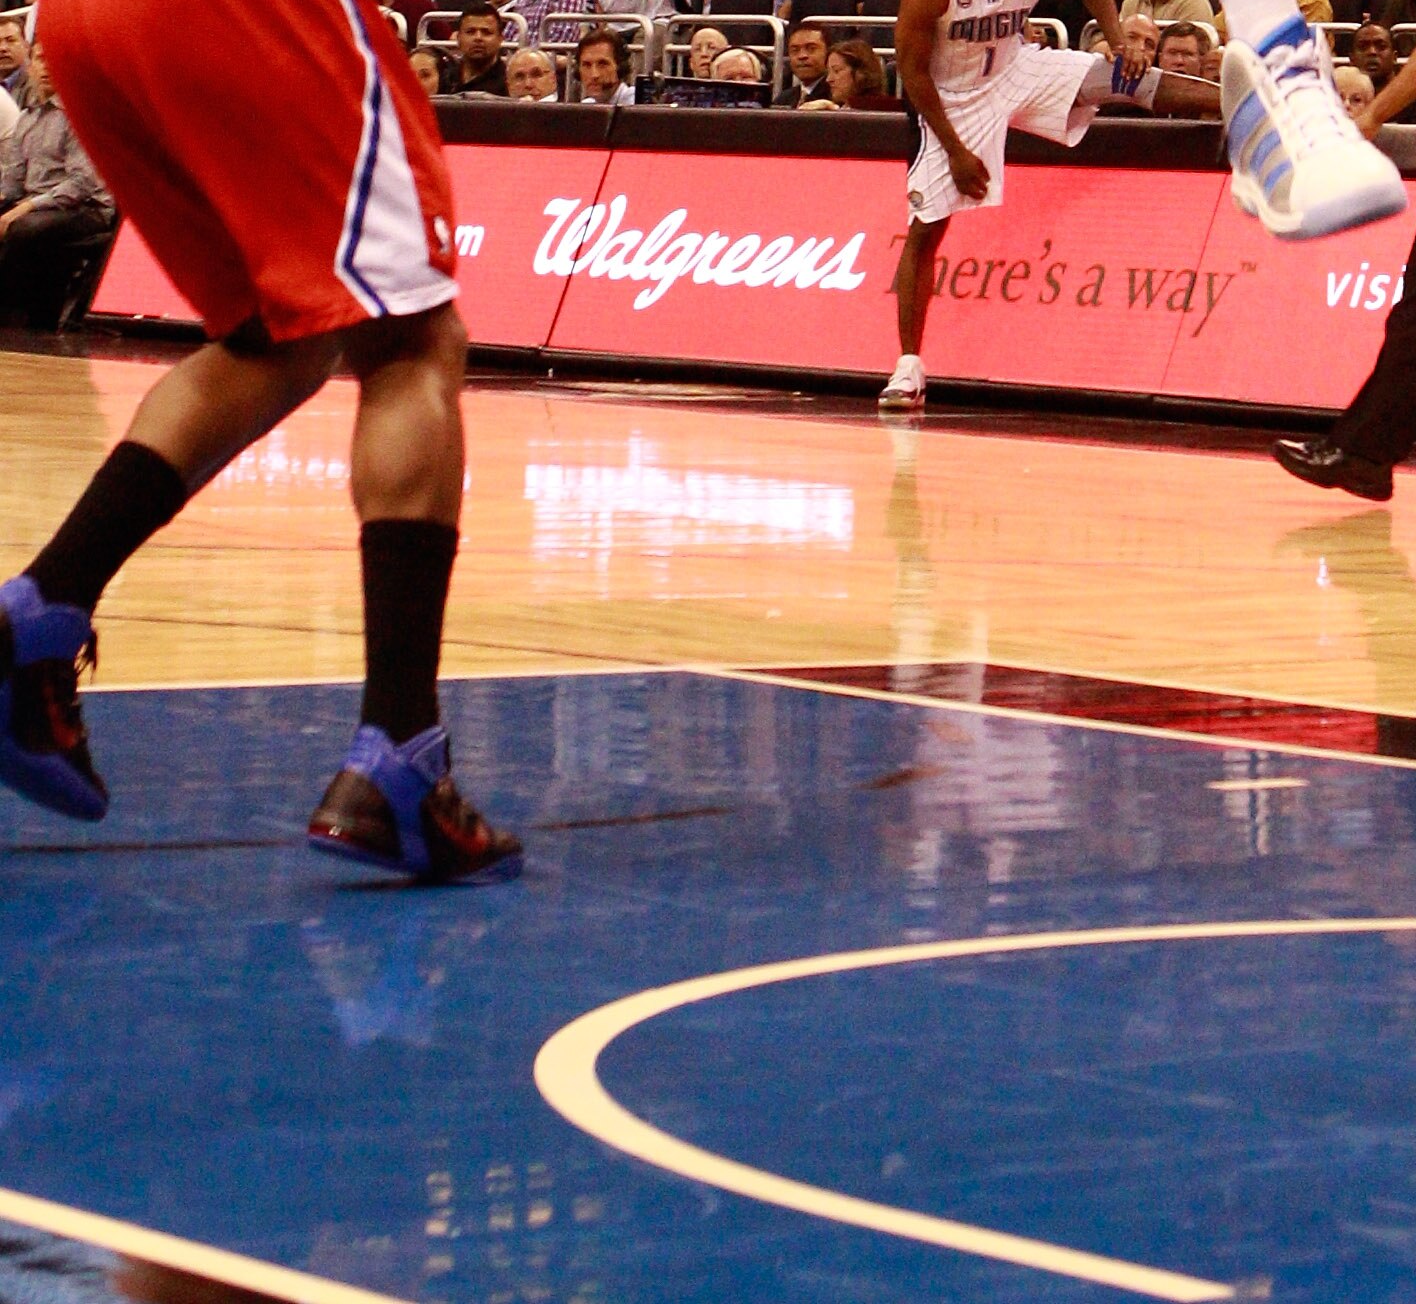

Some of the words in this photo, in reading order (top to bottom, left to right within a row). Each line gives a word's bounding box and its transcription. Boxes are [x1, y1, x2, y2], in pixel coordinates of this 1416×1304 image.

[982, 46, 995, 77] 1
[533, 194, 867, 311] Walgreens
[1077, 263, 1108, 309] a
